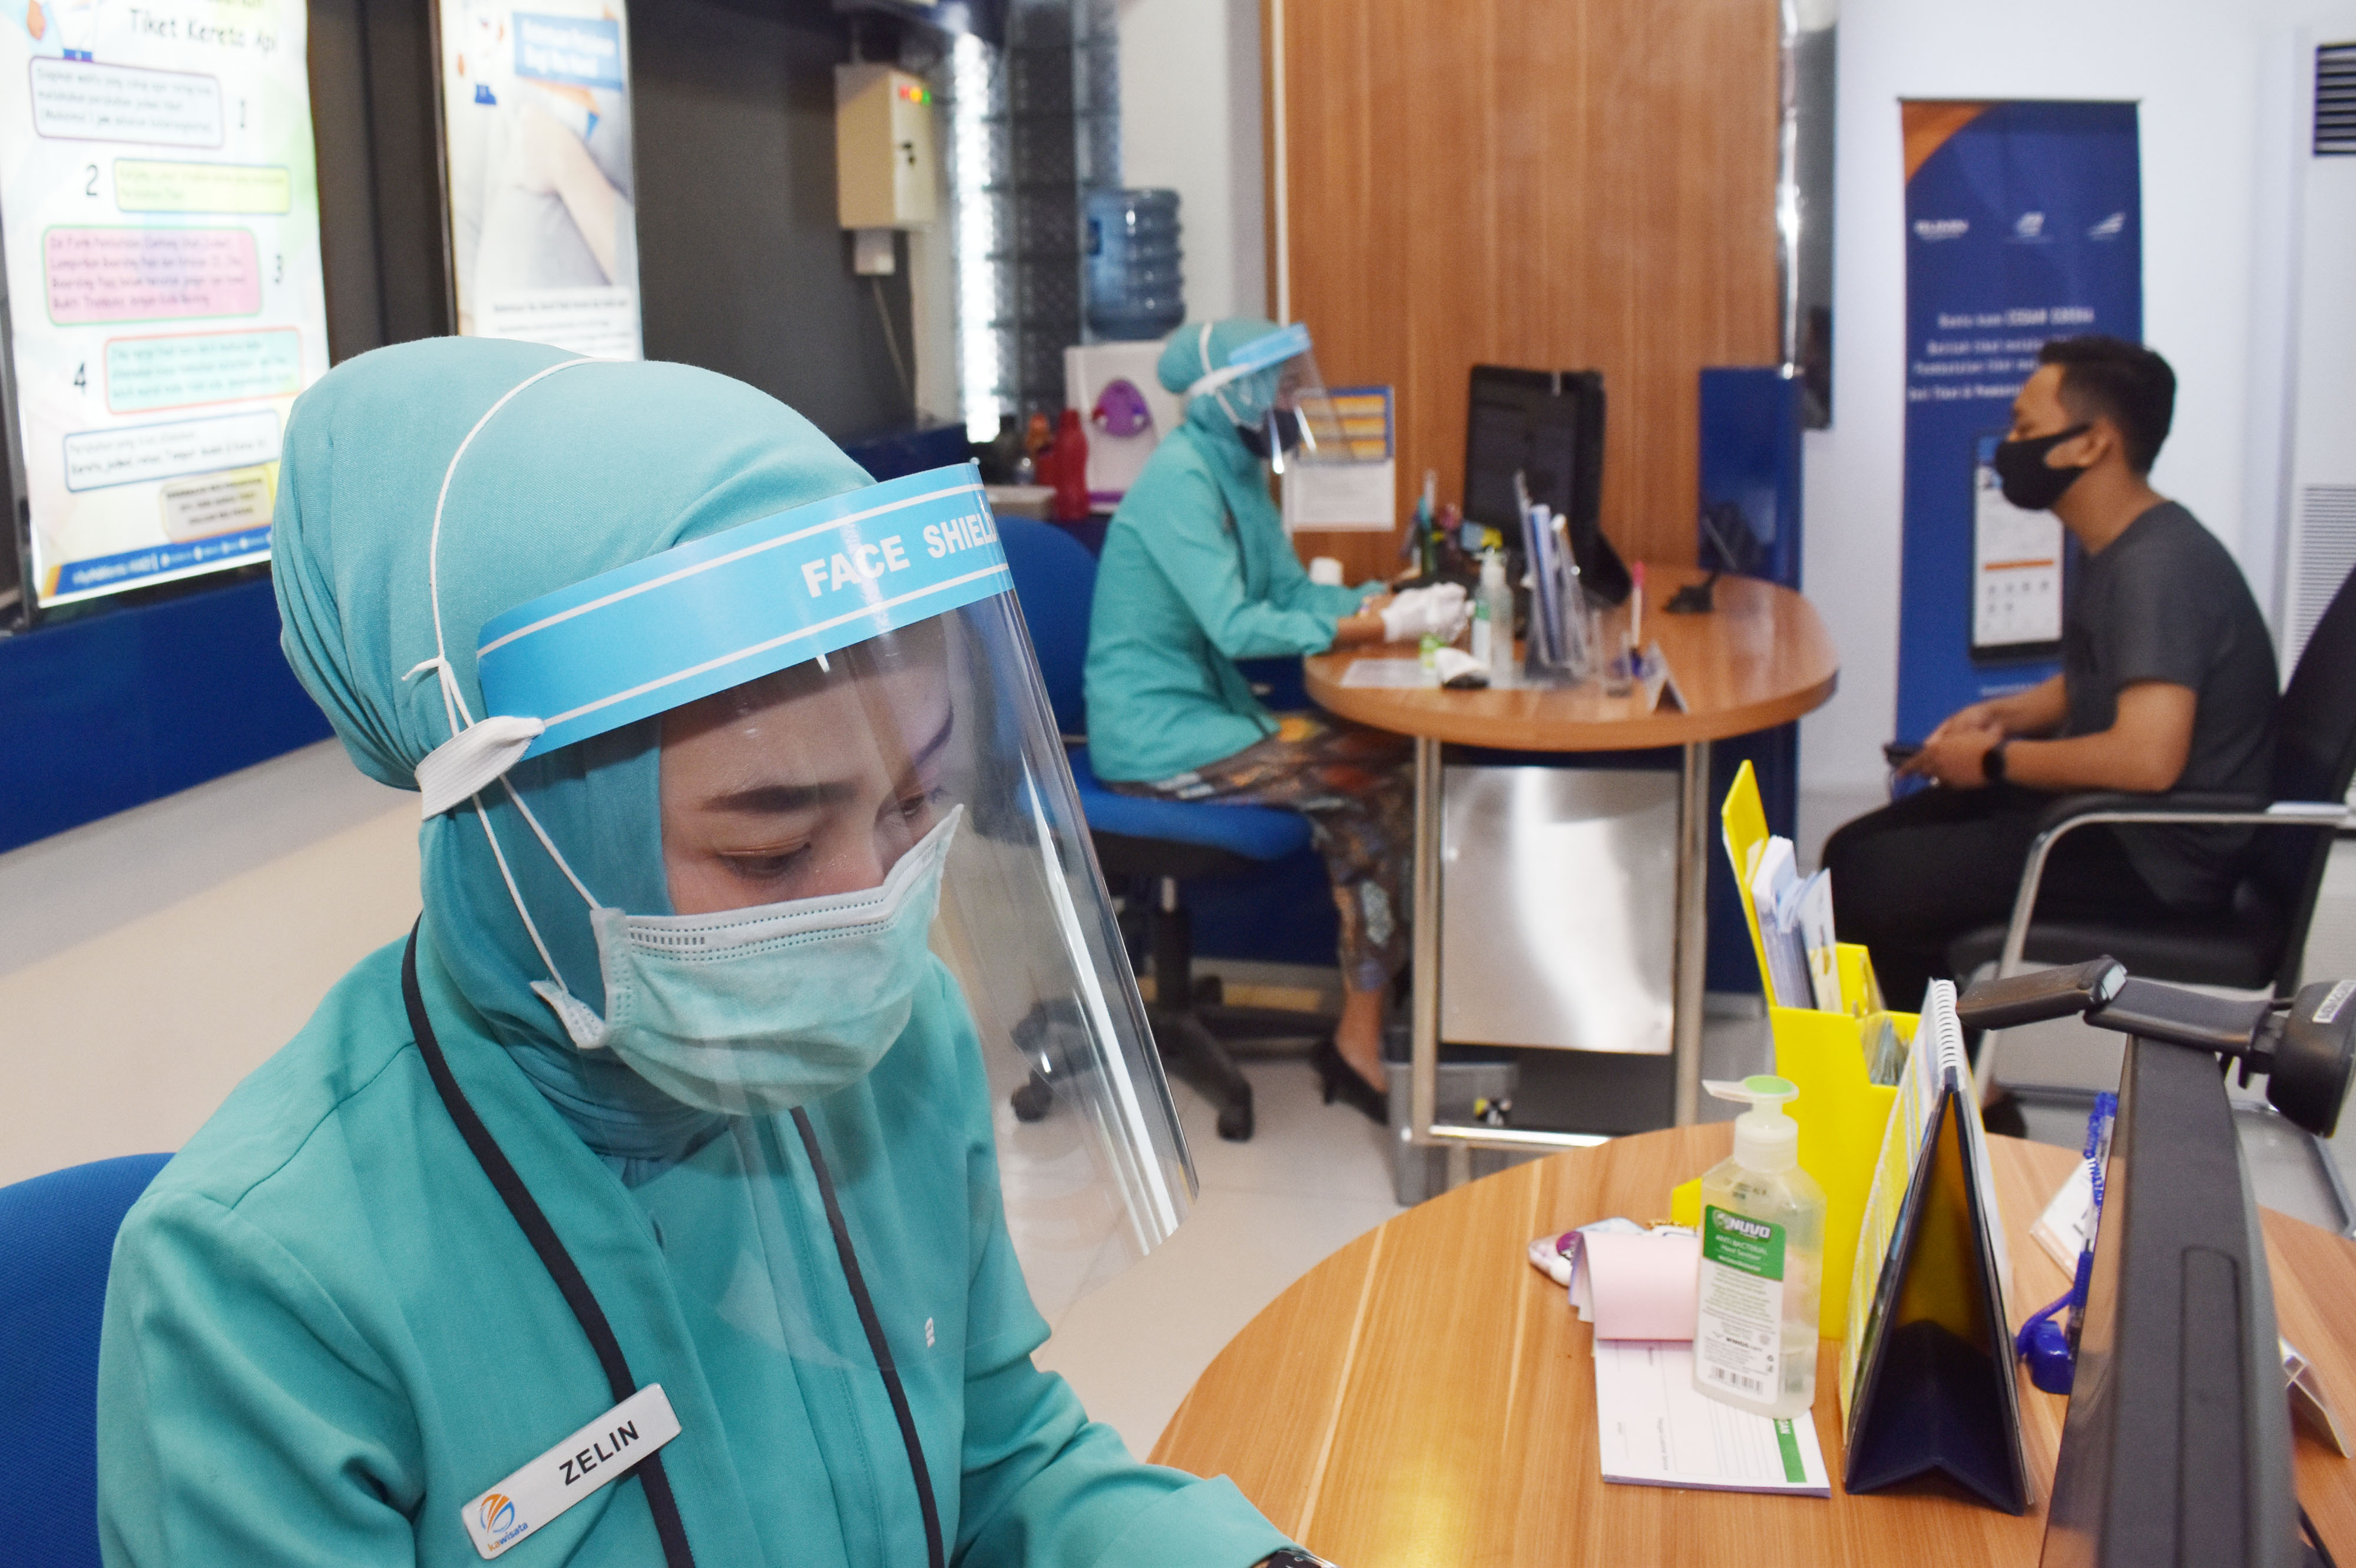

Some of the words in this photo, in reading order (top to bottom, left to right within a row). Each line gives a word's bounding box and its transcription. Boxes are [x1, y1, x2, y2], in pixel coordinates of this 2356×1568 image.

[130, 8, 176, 38] Tiket
[188, 16, 245, 47] Kereta
[254, 28, 277, 55] Api
[239, 100, 246, 129] 1
[86, 164, 98, 196] 2
[274, 253, 284, 284] 3
[74, 362, 87, 394] 4
[800, 535, 911, 598] FACE
[923, 512, 998, 558] SHIELD
[1725, 1217, 1771, 1239] NUVO
[559, 1420, 640, 1486] ZELIN
[488, 1521, 528, 1552] kawisata
